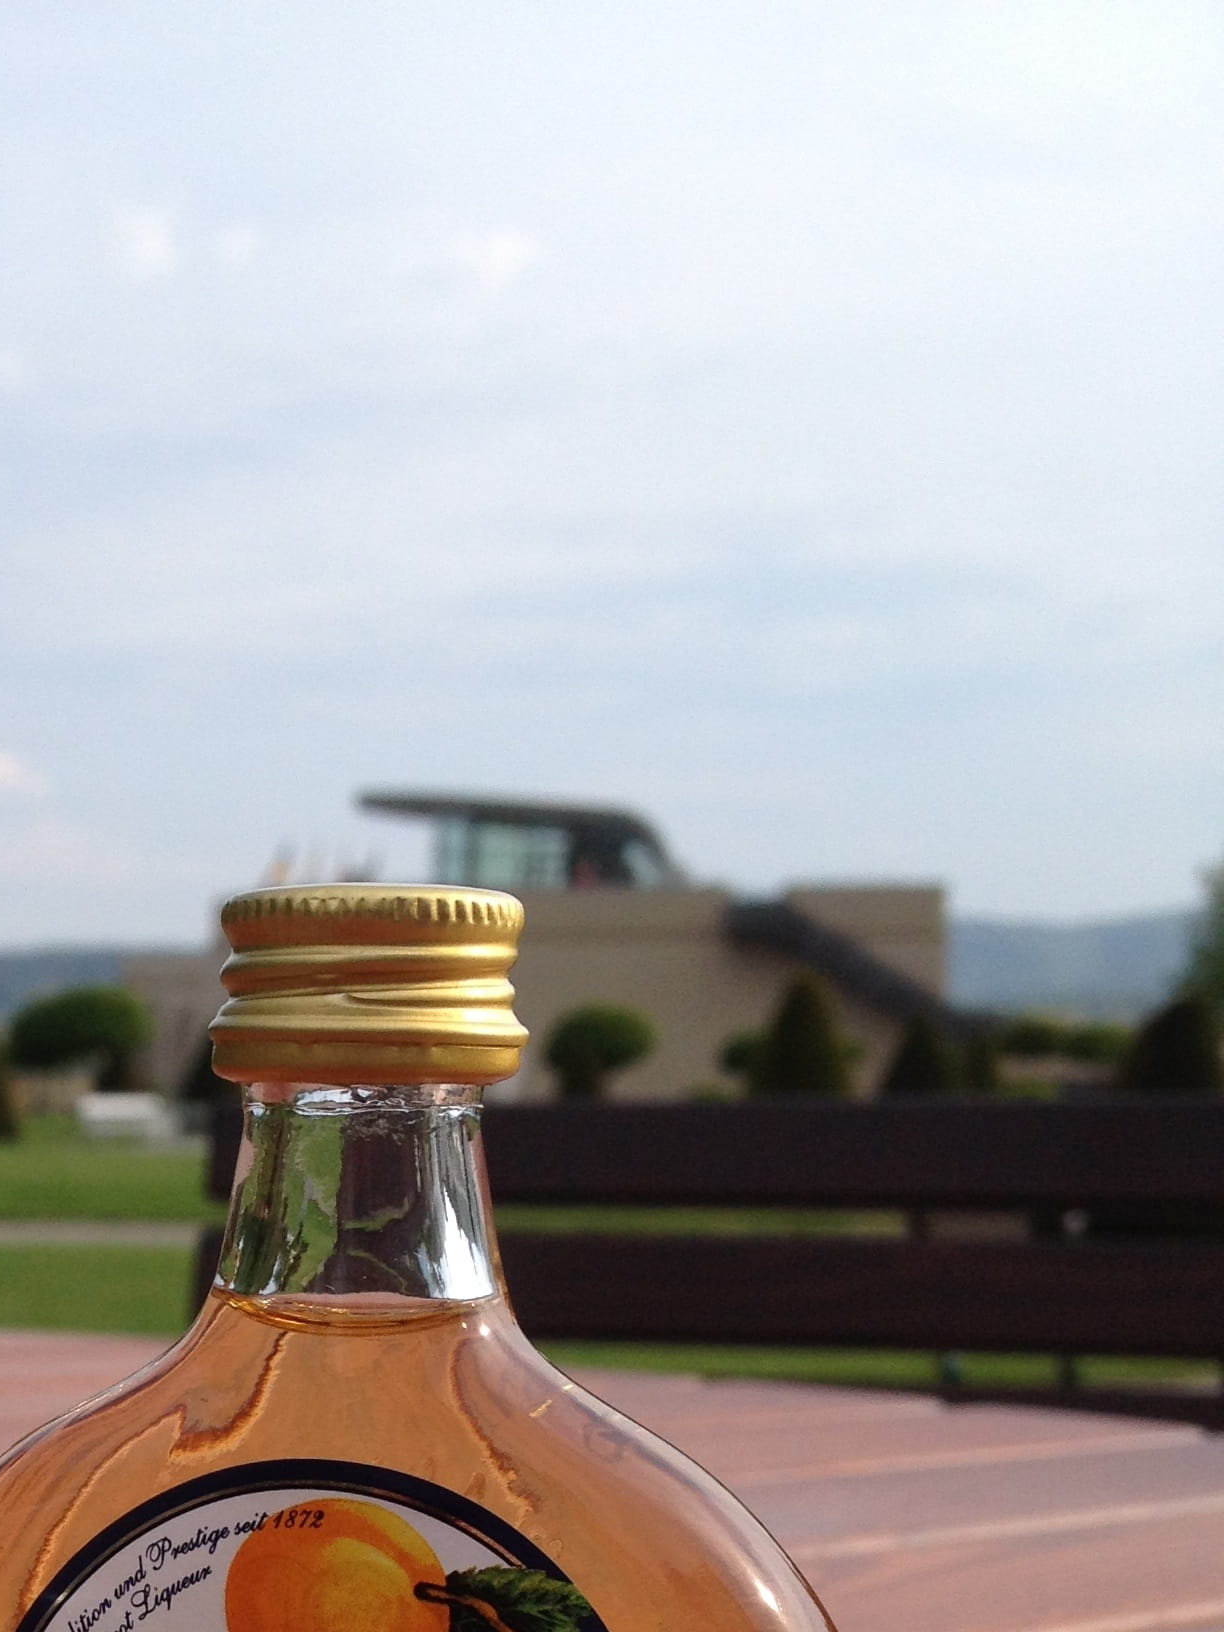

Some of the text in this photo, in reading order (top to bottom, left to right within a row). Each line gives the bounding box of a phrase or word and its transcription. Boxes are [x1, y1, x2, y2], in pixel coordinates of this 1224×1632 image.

[114, 1554, 147, 1600] und
[146, 1536, 230, 1571] Prestige
[234, 1512, 266, 1534] seit
[272, 1509, 325, 1530] 1872
[130, 1564, 213, 1621] Liqueur
